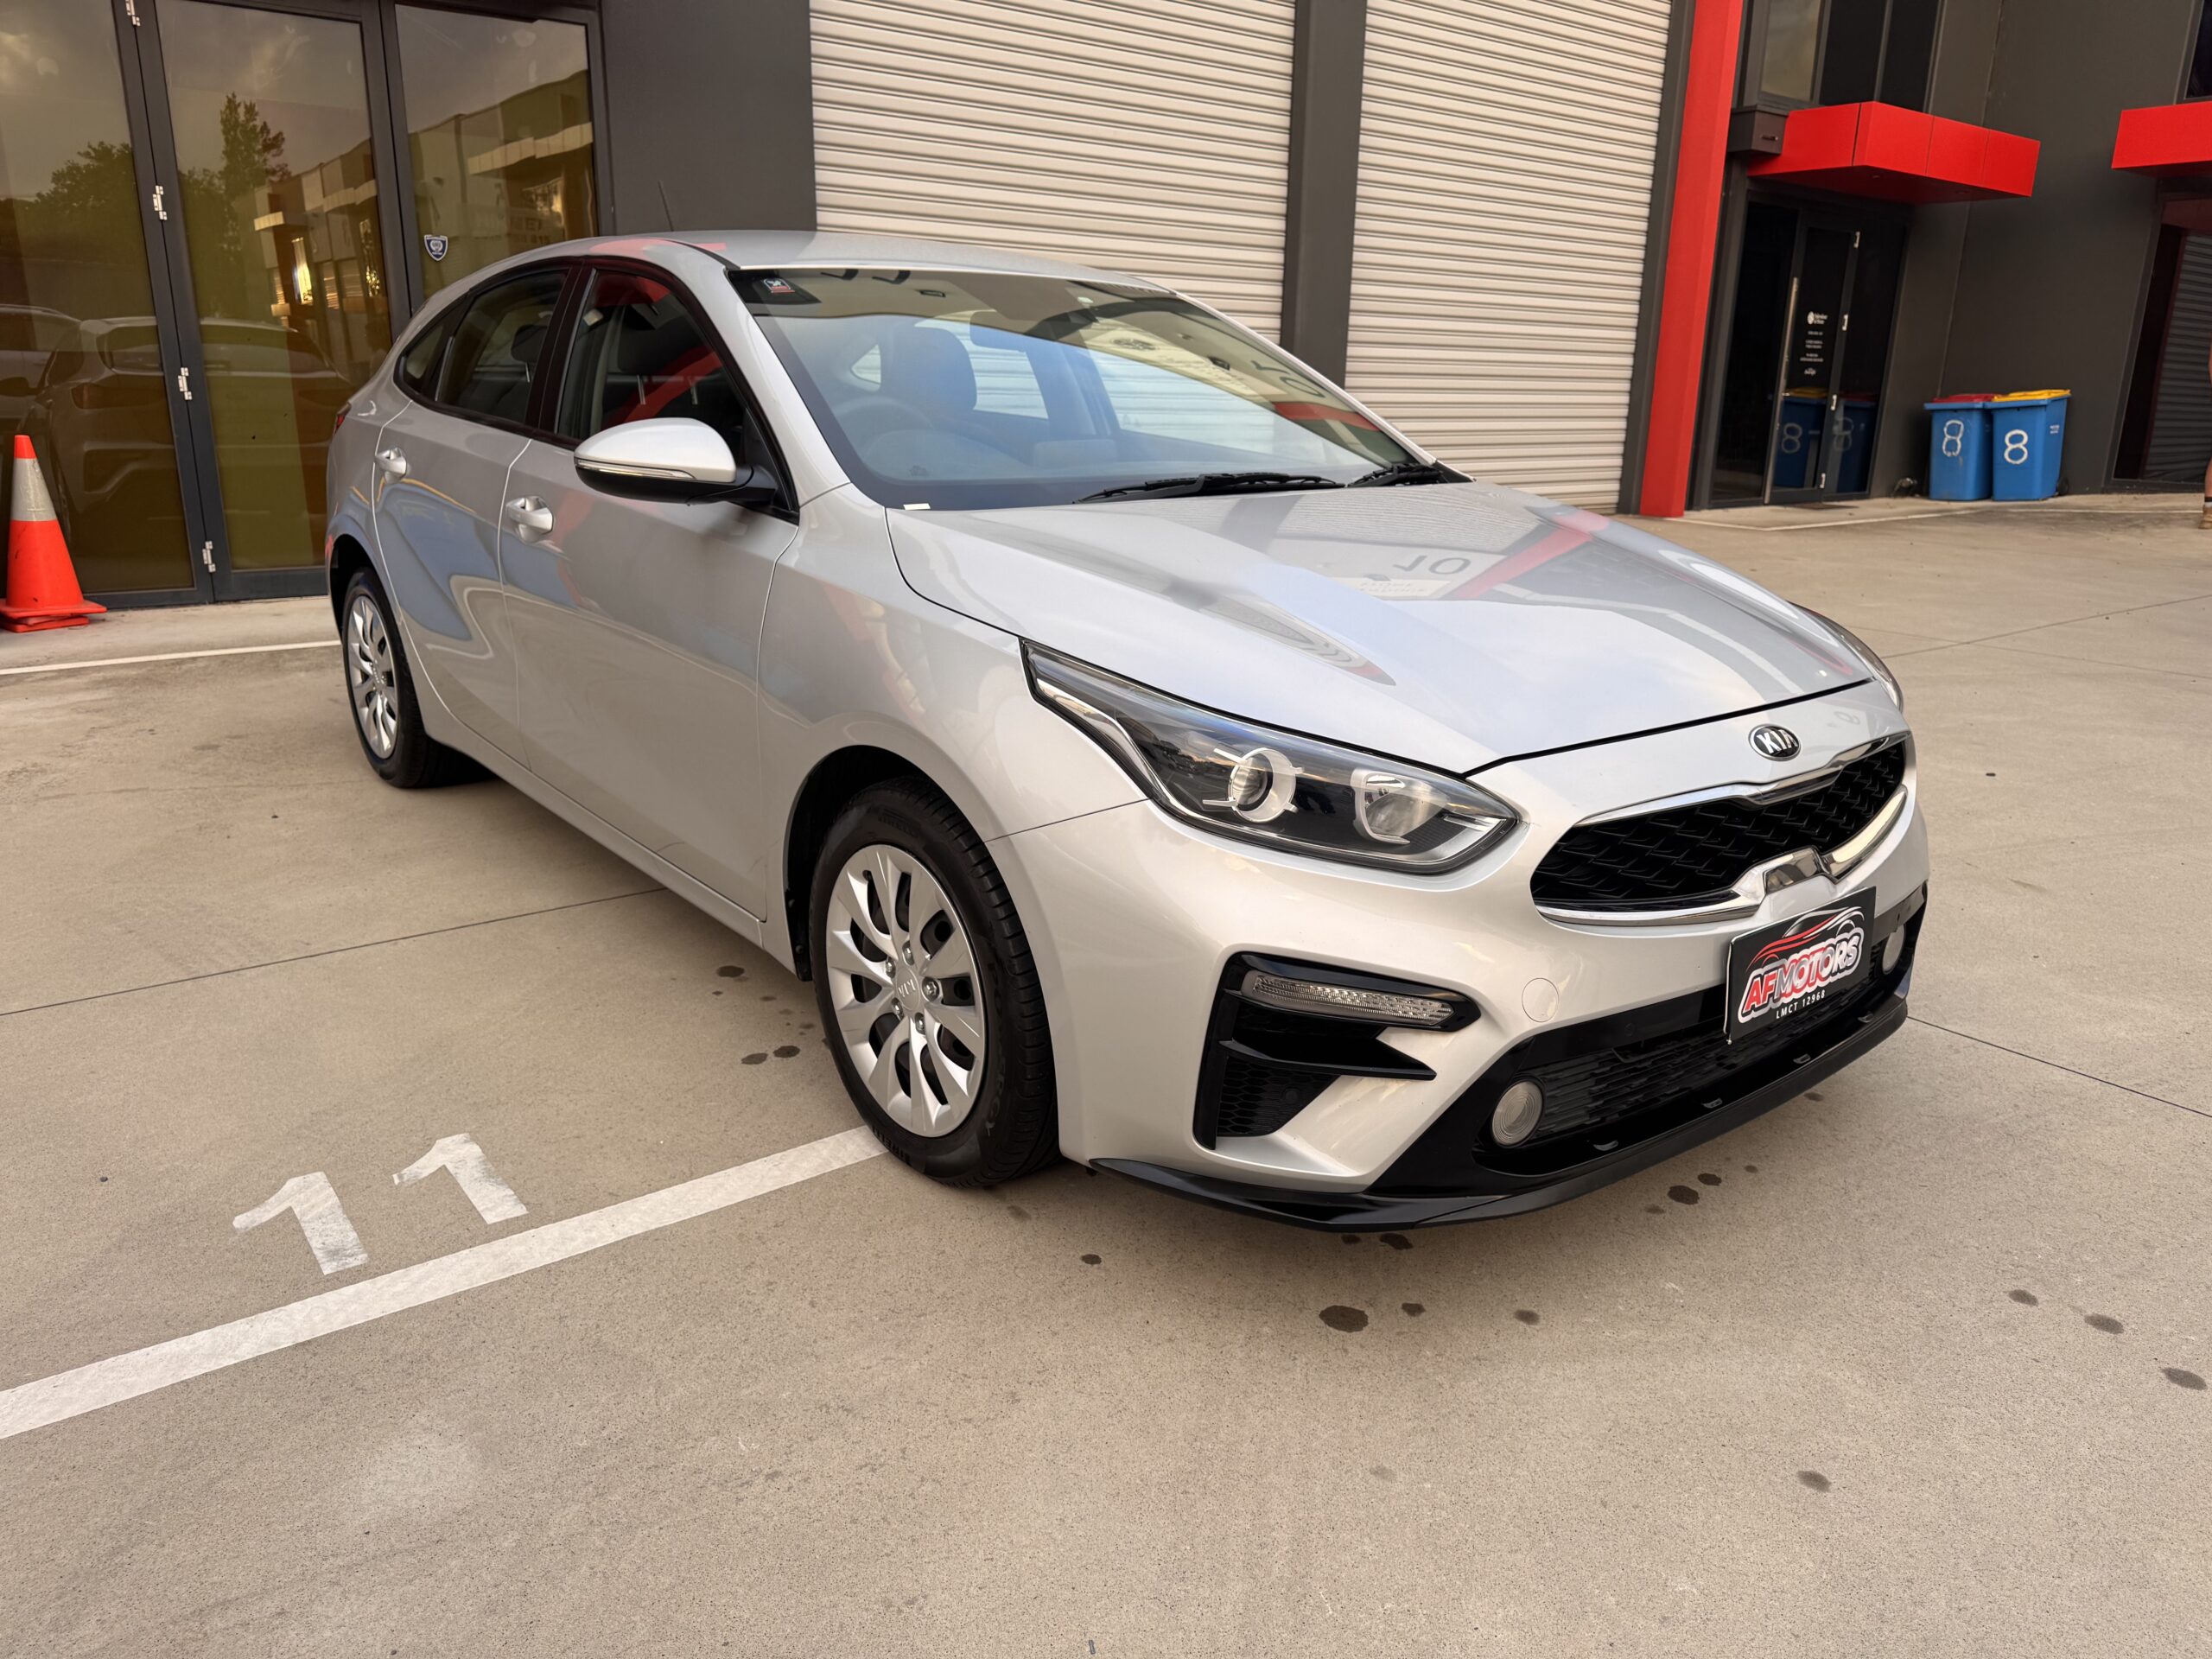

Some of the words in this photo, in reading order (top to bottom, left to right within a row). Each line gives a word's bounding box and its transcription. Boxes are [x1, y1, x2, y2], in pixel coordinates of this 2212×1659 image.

[1942, 419, 1964, 457] 8
[2003, 429, 2029, 465] 8
[1756, 729, 1798, 753] KIA
[1776, 1001, 1798, 1020] LMCT
[1802, 989, 1826, 1007] 12968
